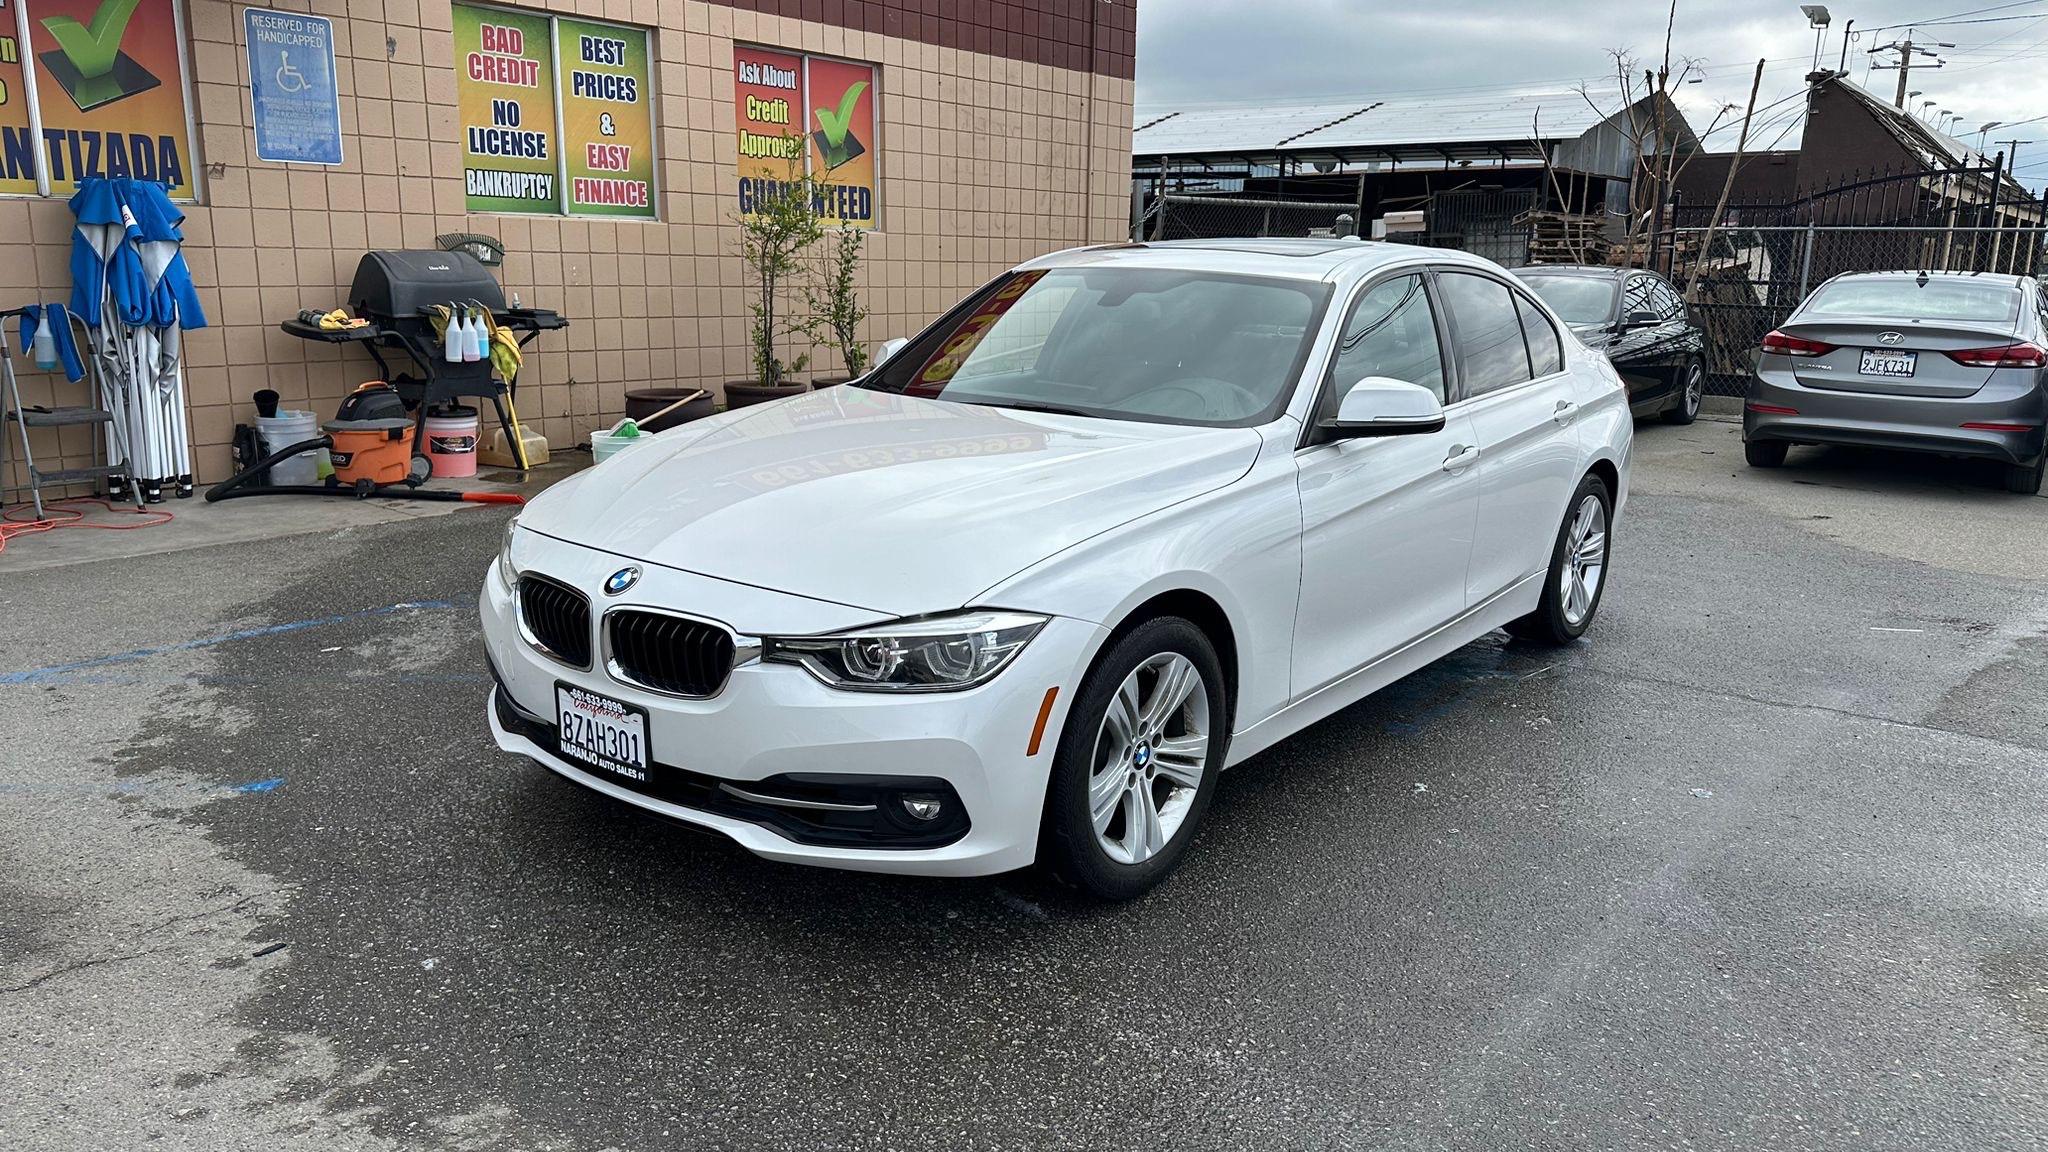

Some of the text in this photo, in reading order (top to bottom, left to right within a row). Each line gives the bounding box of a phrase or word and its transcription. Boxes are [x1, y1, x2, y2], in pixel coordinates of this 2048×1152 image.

[251, 15, 326, 35] RESERVED FOR
[257, 29, 323, 48] HANDICAPPED
[481, 24, 523, 55] BAD
[580, 35, 625, 66] BEST
[468, 53, 539, 87] CREDIT
[738, 60, 797, 90] Ask About
[572, 70, 637, 103] PRICES
[492, 99, 520, 128] NO
[600, 112, 616, 136] &
[746, 94, 790, 124] Credit
[0, 126, 184, 186] NTIZADA
[468, 127, 547, 159] LICENSE
[587, 144, 630, 171] EASY
[465, 169, 553, 200] BANKRUPTCY
[573, 178, 647, 206] FINANCE
[739, 176, 871, 220] GUARNTEED
[1863, 358, 1910, 372] 9JEK731
[563, 710, 643, 768] 8ZAH301
[560, 739, 599, 766] NARANJO
[598, 758, 616, 771] AUTO
[616, 765, 637, 779] SALES
